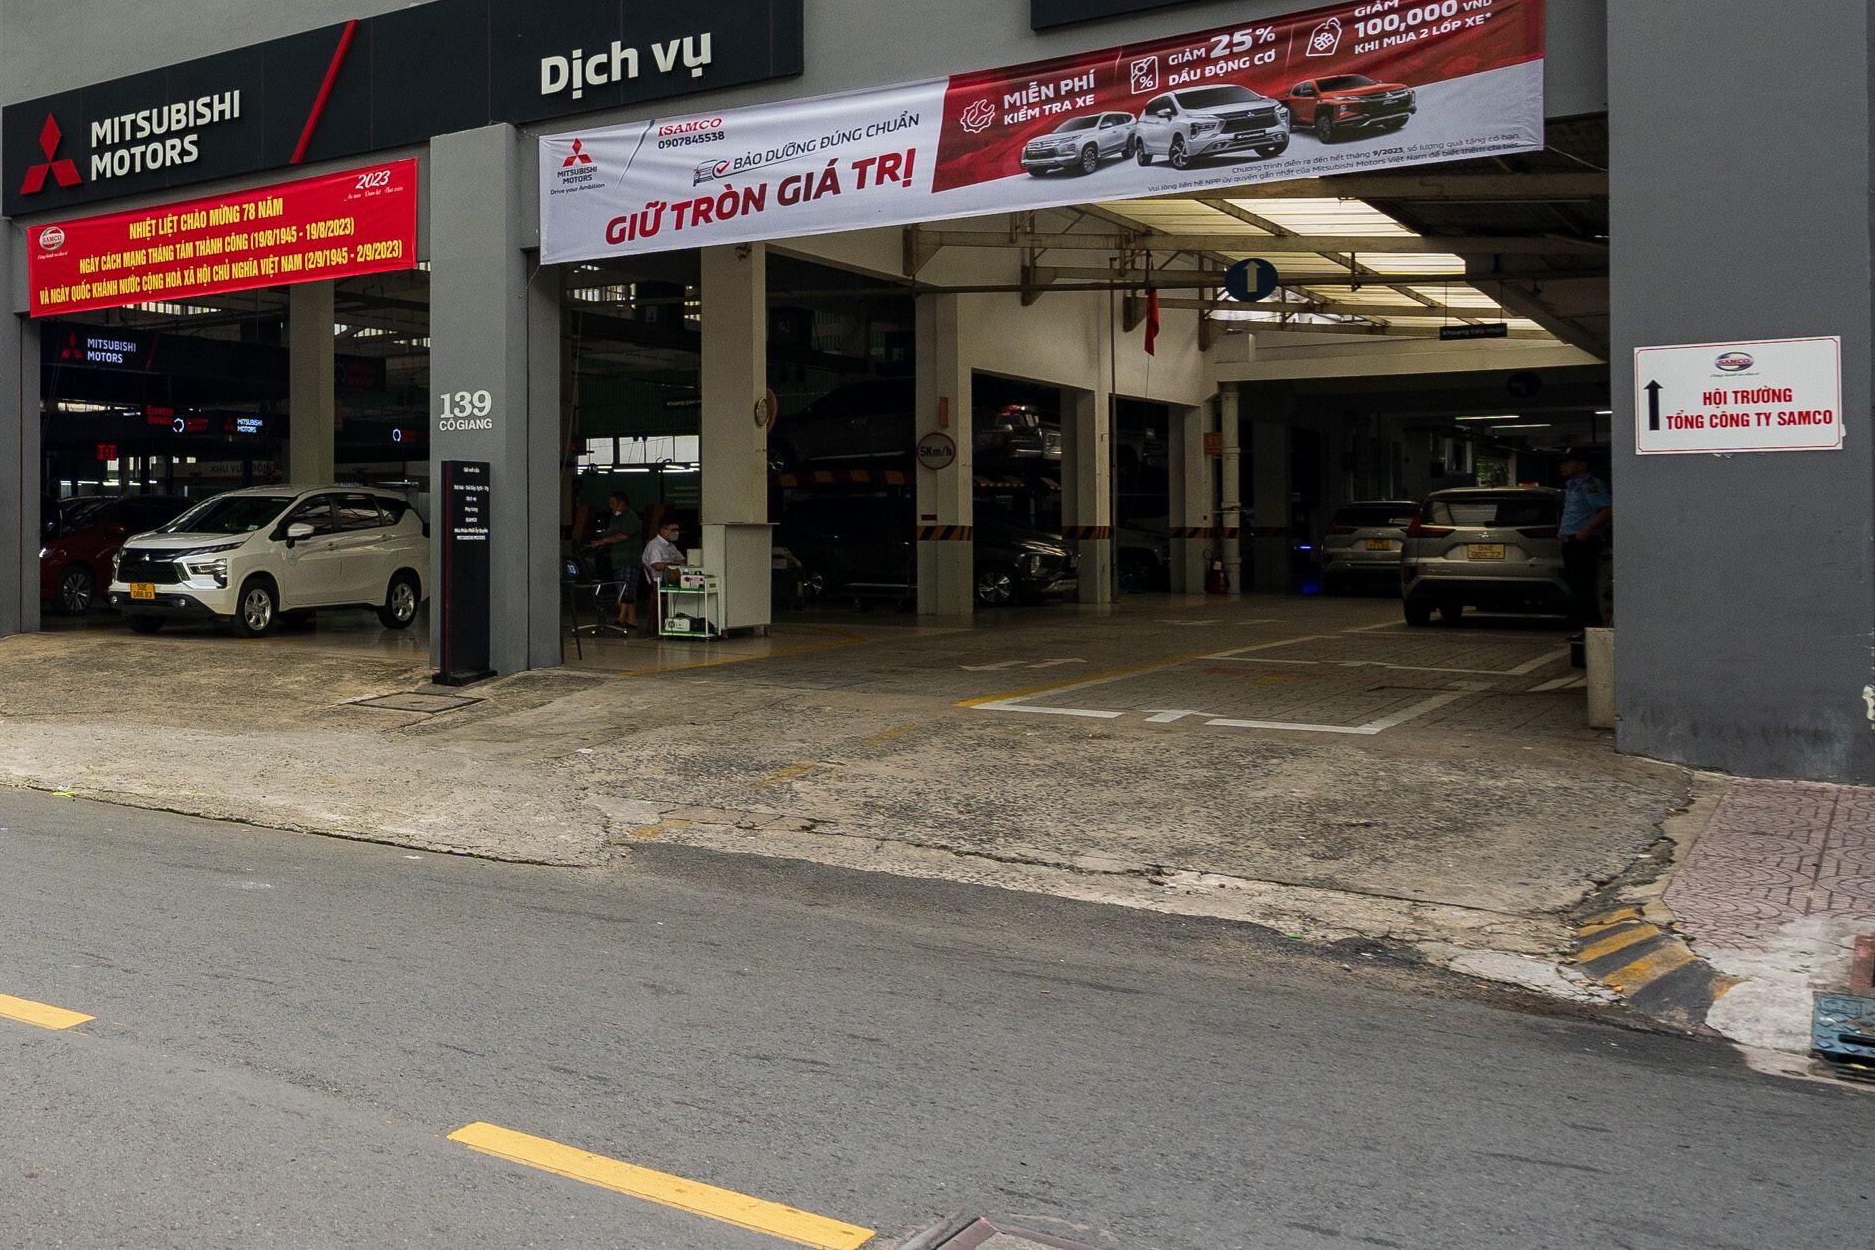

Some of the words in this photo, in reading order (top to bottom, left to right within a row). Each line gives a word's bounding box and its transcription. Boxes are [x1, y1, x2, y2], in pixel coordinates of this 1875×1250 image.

[1354, 0, 1458, 38] 100,000
[1168, 48, 1206, 66] GIẢM
[1210, 26, 1276, 59] 25%
[1354, 42, 1379, 55] KHI
[1383, 33, 1417, 48] MUA
[1420, 28, 1429, 39] 2
[1432, 19, 1462, 36] LỐP
[541, 40, 639, 100] Dịch
[651, 32, 712, 78] vụ
[1169, 68, 1201, 86] DẦU
[1205, 57, 1250, 77] ĐỘNG
[1254, 49, 1276, 65] CƠ
[1003, 81, 1055, 109] MIỄN
[1060, 68, 1096, 95] PHÍ
[1043, 100, 1072, 116] TRA
[1075, 94, 1095, 108] XE
[91, 90, 240, 148] MITSUBISHI
[657, 118, 723, 137] ISAMCO
[658, 131, 725, 150] 0907845538
[733, 151, 762, 170] BẢO
[765, 139, 817, 162] DƯỠNG
[819, 128, 863, 149] ĐÚNG
[866, 110, 920, 138] CHUẨN
[91, 134, 198, 181] MOTORS
[355, 170, 391, 190] 2023
[557, 165, 598, 179] MITSUBISHI
[562, 175, 593, 185] MOTORS
[550, 188, 565, 196] Drive
[565, 186, 579, 195] your
[579, 183, 606, 192] Ambition
[605, 200, 667, 245] GIỮ
[670, 183, 768, 231] TRÒN
[777, 157, 841, 207] GIÁ
[851, 148, 916, 190] TRỊ
[129, 217, 157, 241] NHIỆT
[159, 214, 179, 238] LIỆT
[181, 208, 207, 232] CHÀO
[209, 203, 240, 228] MỪNG
[243, 202, 256, 221] 78
[257, 195, 283, 219] NĂM
[79, 257, 100, 274] NGÀY
[101, 247, 121, 271] CÁCH
[123, 251, 147, 270] MẠNG
[148, 244, 175, 265] THÁNG
[176, 239, 194, 260] TÁM
[195, 232, 223, 256] THÀNH
[225, 232, 248, 252] CÔNG
[251, 225, 297, 250] (19/8/1945
[305, 217, 355, 241] 19/8/2023)
[39, 286, 50, 305] VÀ
[51, 284, 70, 304] NGÀY
[71, 278, 91, 302] QUỐC
[92, 274, 118, 299] KHÁNH
[119, 276, 141, 295] NƯỚC
[142, 272, 164, 294] CỘNG
[183, 266, 195, 285] XÃ
[197, 263, 211, 287] HỘI
[213, 258, 230, 281] CHỦ
[231, 256, 259, 279] NGHĨA
[260, 254, 279, 278] VIỆT
[281, 253, 303, 272] NAM
[305, 247, 349, 271] (2/9/1945
[357, 239, 403, 263] 2/9/2023)
[87, 338, 137, 352] MITSUBISHI
[87, 351, 123, 364] MOTORS
[1717, 358, 1751, 366] SAMCO
[440, 390, 493, 419] 139
[1703, 388, 1727, 409] HỘI
[1731, 385, 1793, 405] TRƯỜNG
[439, 418, 456, 432] CÔ
[456, 418, 493, 431] GIANG
[1665, 409, 1705, 430] TỔNG
[1709, 411, 1751, 429] CÔNG
[1755, 411, 1773, 427] TY
[1777, 409, 1833, 426] SAMCO
[920, 446, 952, 458] 5Km/h
